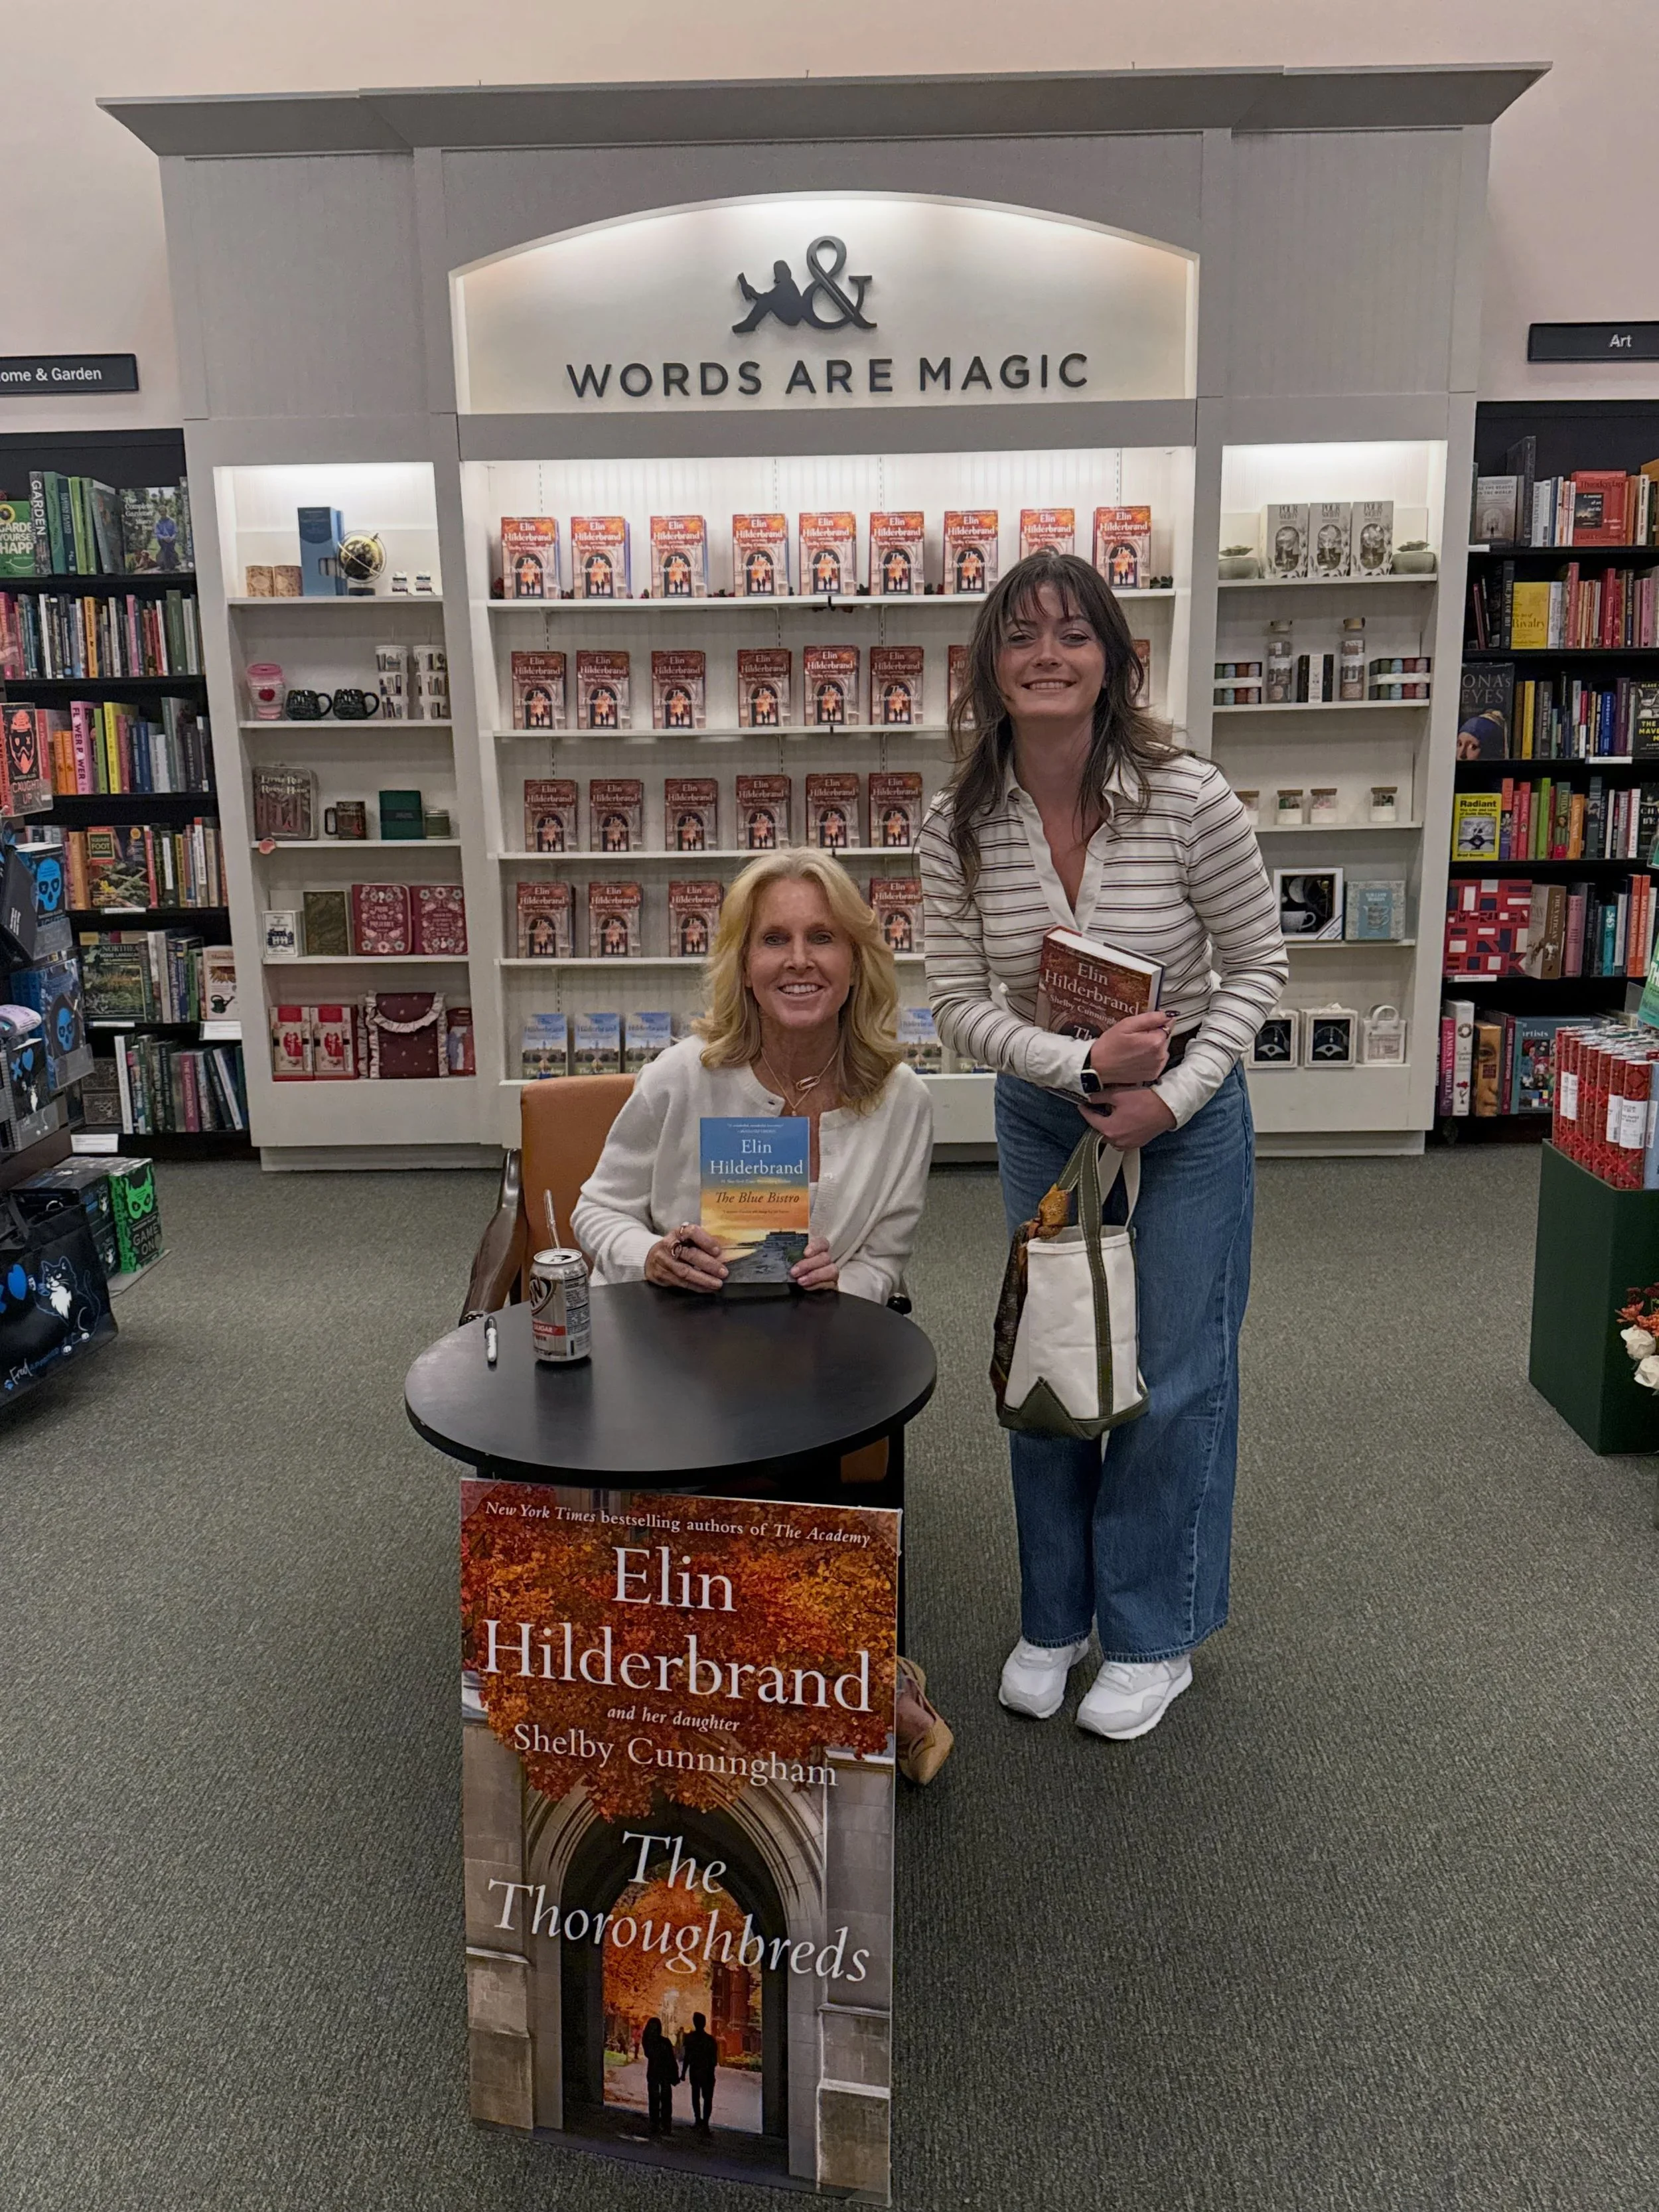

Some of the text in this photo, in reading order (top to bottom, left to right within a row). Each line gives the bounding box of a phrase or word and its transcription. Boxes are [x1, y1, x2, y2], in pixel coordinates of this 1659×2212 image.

[1609, 334, 1632, 348] Art
[0, 367, 102, 383] ome & Garden
[567, 353, 1088, 398] WORDS ARE MAGIC
[31, 480, 46, 536] GARDEN
[818, 518, 833, 526] Elin
[889, 518, 905, 526] Elin
[964, 516, 979, 524] Elin
[1041, 514, 1056, 522] Elin
[1116, 512, 1131, 520] Elin
[0, 522, 32, 532] GARDE
[589, 522, 605, 531] Elin
[751, 519, 767, 528] Elin
[1024, 525, 1071, 534] Hilderbrand
[1100, 522, 1147, 531] Hilderbrand
[575, 532, 621, 541] Hilderbrand
[654, 532, 699, 540] Hilderbrand
[736, 530, 782, 538] Hilderbrand
[803, 528, 849, 536] Hilderbrand
[874, 528, 920, 536] Hilderbrand
[948, 526, 995, 536] Hilderbrand
[0, 533, 32, 542] YOURSE
[504, 533, 551, 542] Hilderbrand
[0, 542, 33, 553] HAPP
[1513, 618, 1545, 630] Rivalry
[822, 651, 837, 660] Elin
[889, 652, 904, 660] Elin
[515, 666, 560, 675] Hilderbrand
[741, 664, 786, 673] Hilderbrand
[807, 661, 853, 670] Hilderbrand
[874, 662, 920, 670] Hilderbrand
[1462, 673, 1511, 688] ONA's
[1462, 689, 1503, 703] EYES
[72, 707, 86, 780] FLWER PWER
[13, 780, 38, 792] CAUGHT
[541, 784, 556, 793] Elin
[607, 784, 622, 792] Elin
[23, 795, 33, 804] UP
[1560, 790, 1569, 814] FRIDA
[1447, 910, 1529, 924] AMERICAN
[1607, 911, 1616, 928] 365
[1446, 924, 1528, 954] ART
[102, 944, 139, 953] NORTHE
[1444, 954, 1526, 974] BOOK
[1078, 962, 1108, 986] Elin
[1045, 969, 1140, 1015] Hilderbrand
[1050, 995, 1118, 1025] Shelby Cunningh
[1074, 1025, 1094, 1041] Th
[741, 1139, 772, 1153] Elin
[710, 1159, 803, 1175] Hilderbrand
[716, 1191, 800, 1203] The Blue Bistro
[133, 1224, 160, 1246] GAME
[141, 1238, 156, 1256] ON
[9, 1359, 34, 1384] Fred
[486, 1501, 871, 1548] New York Times bestselling authors of The Academy
[612, 1546, 737, 1611] Elin
[478, 1619, 873, 1712] Hilderbrand
[607, 1706, 740, 1732] and her daughter
[514, 1724, 839, 1787] Shelby Cunningham
[622, 1830, 727, 1894] The
[488, 1878, 871, 1982] Thoroughbreds
